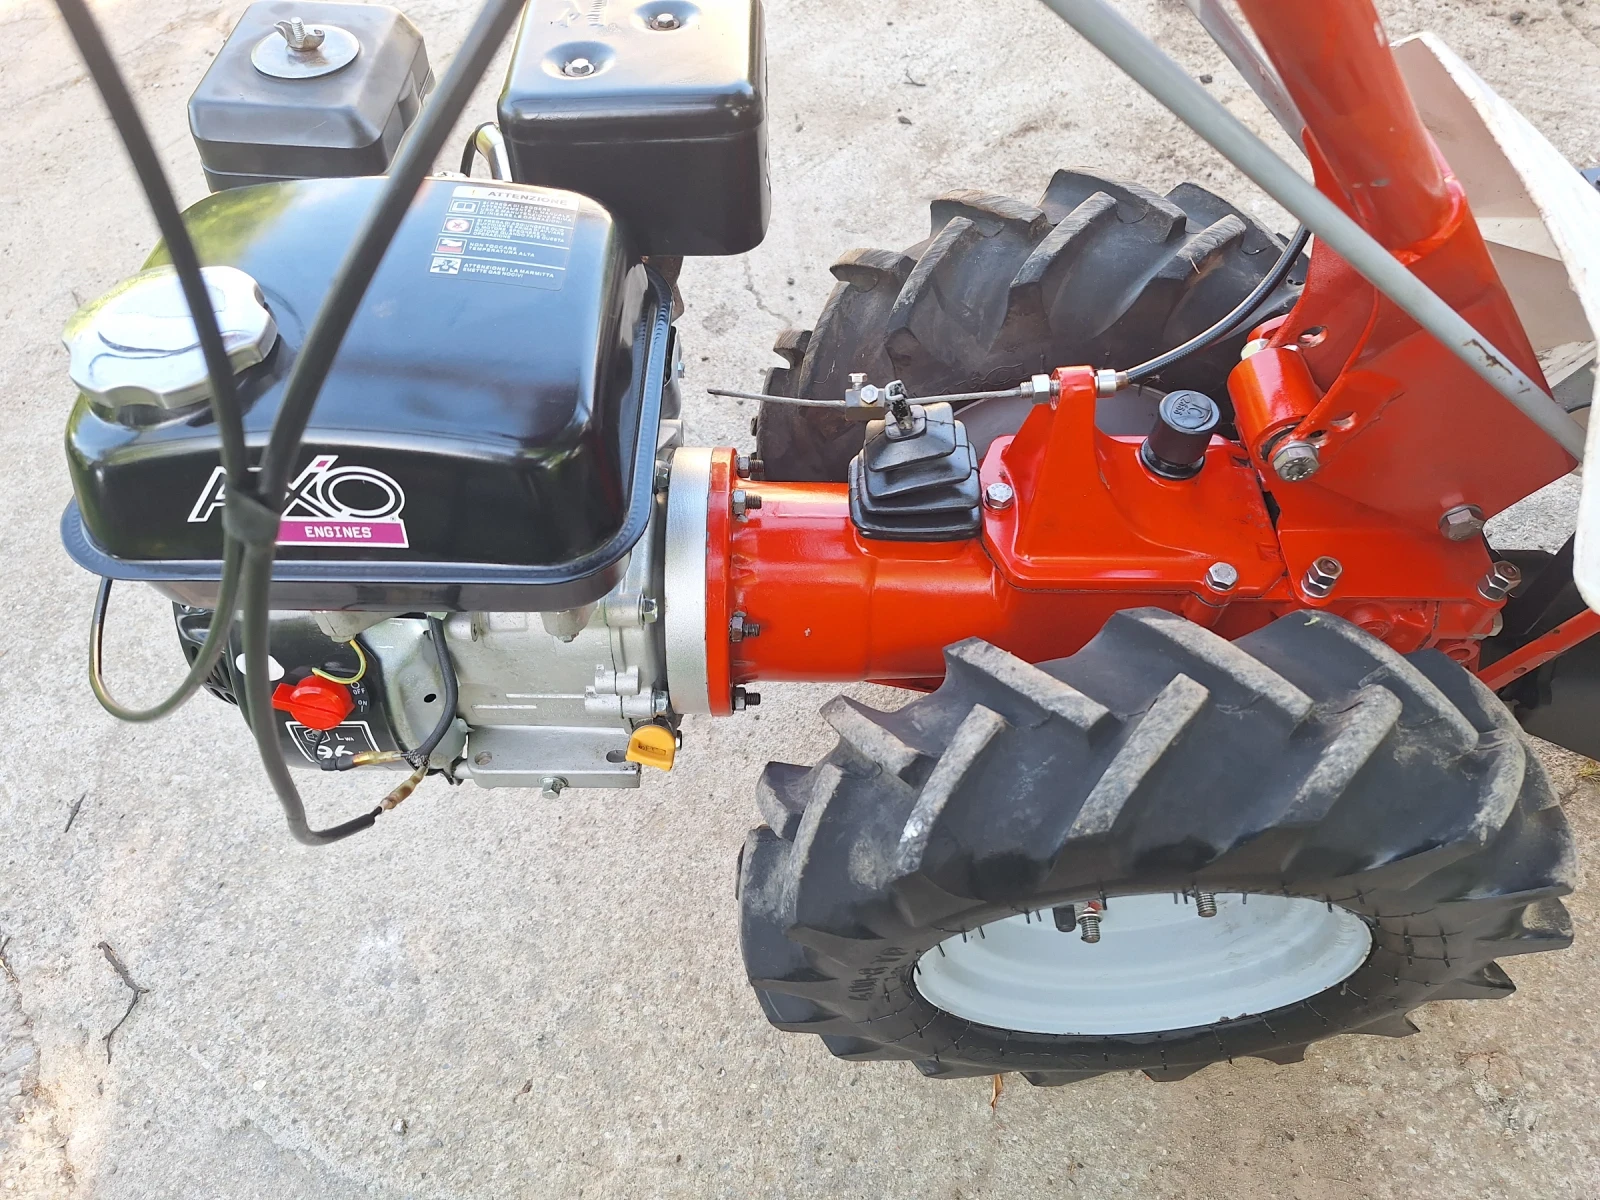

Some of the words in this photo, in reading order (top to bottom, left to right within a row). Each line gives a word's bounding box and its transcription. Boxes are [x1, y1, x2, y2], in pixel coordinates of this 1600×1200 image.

[488, 191, 567, 205] ATTENZIONE
[540, 210, 570, 218] MANUALE
[469, 246, 518, 255] TEMPERATURA
[485, 243, 517, 251] TOCCARE
[520, 269, 554, 278] MARMITTA
[304, 526, 372, 539] ENGINES
[353, 687, 365, 695] OFF
